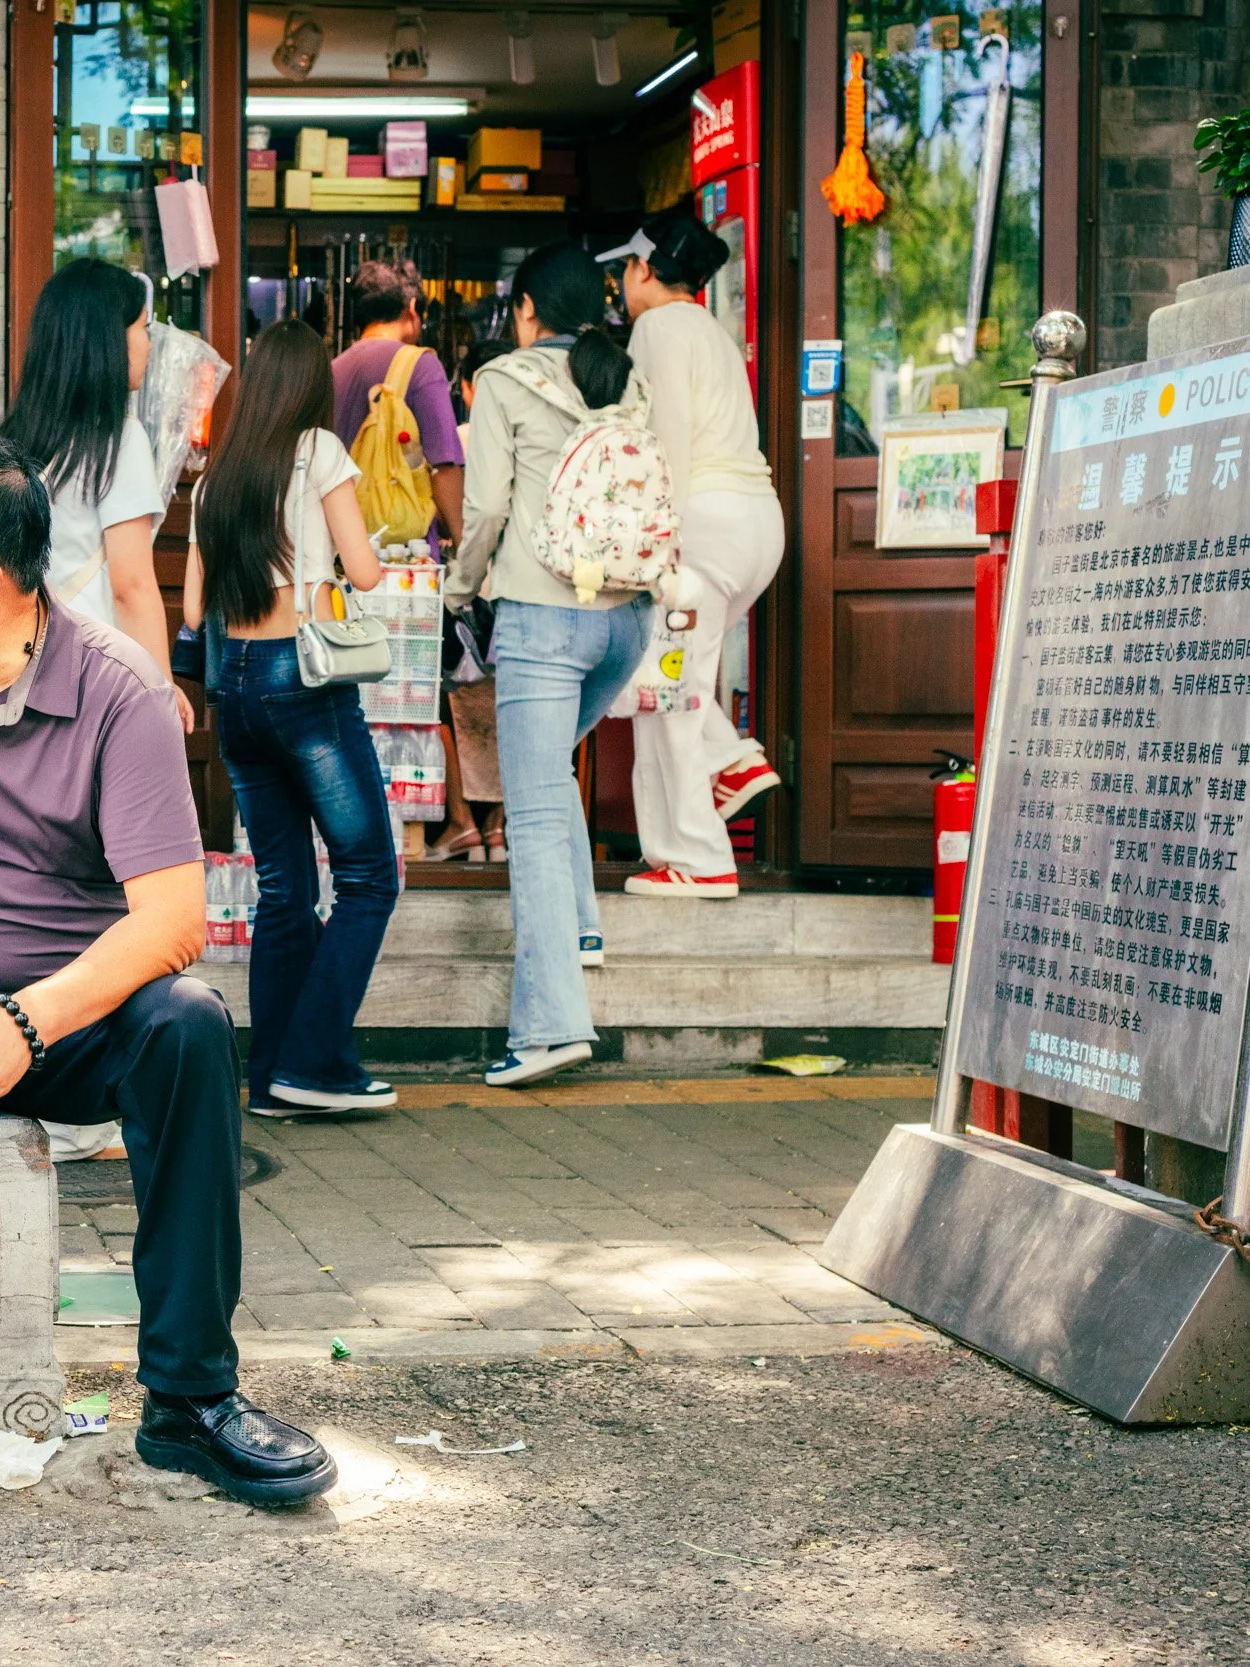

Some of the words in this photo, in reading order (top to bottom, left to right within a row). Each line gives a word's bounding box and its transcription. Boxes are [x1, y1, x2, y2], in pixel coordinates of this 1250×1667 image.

[1101, 387, 1149, 433] 警察
[1186, 366, 1250, 411] POLIC
[1078, 436, 1243, 510] 温馨提示
